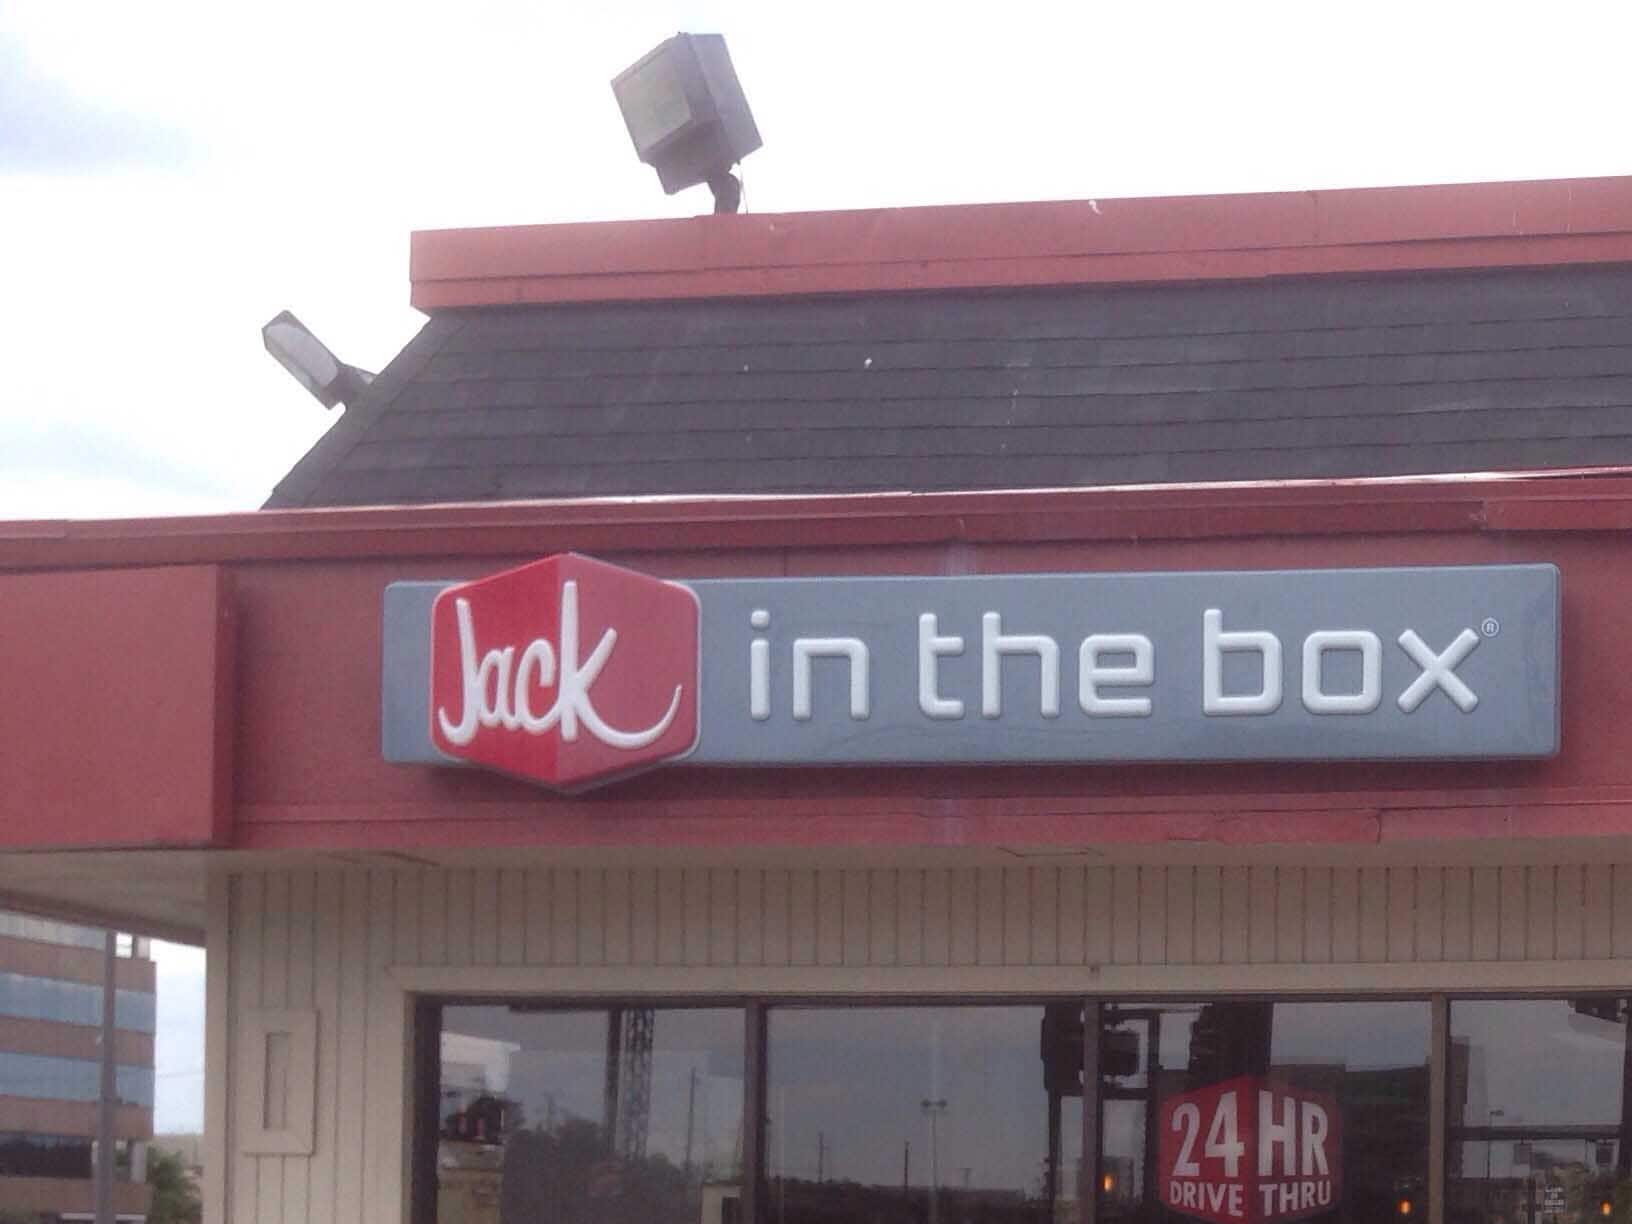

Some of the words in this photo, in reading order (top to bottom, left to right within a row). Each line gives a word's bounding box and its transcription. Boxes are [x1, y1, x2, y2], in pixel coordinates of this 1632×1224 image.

[438, 579, 683, 749] Jack
[750, 609, 870, 721] in
[918, 611, 1155, 720] the
[1202, 608, 1480, 717] box
[1171, 1091, 1245, 1177] 24
[1258, 1090, 1329, 1177] HR
[1169, 1181, 1244, 1217] DRIVE
[1258, 1180, 1332, 1217] THRU
